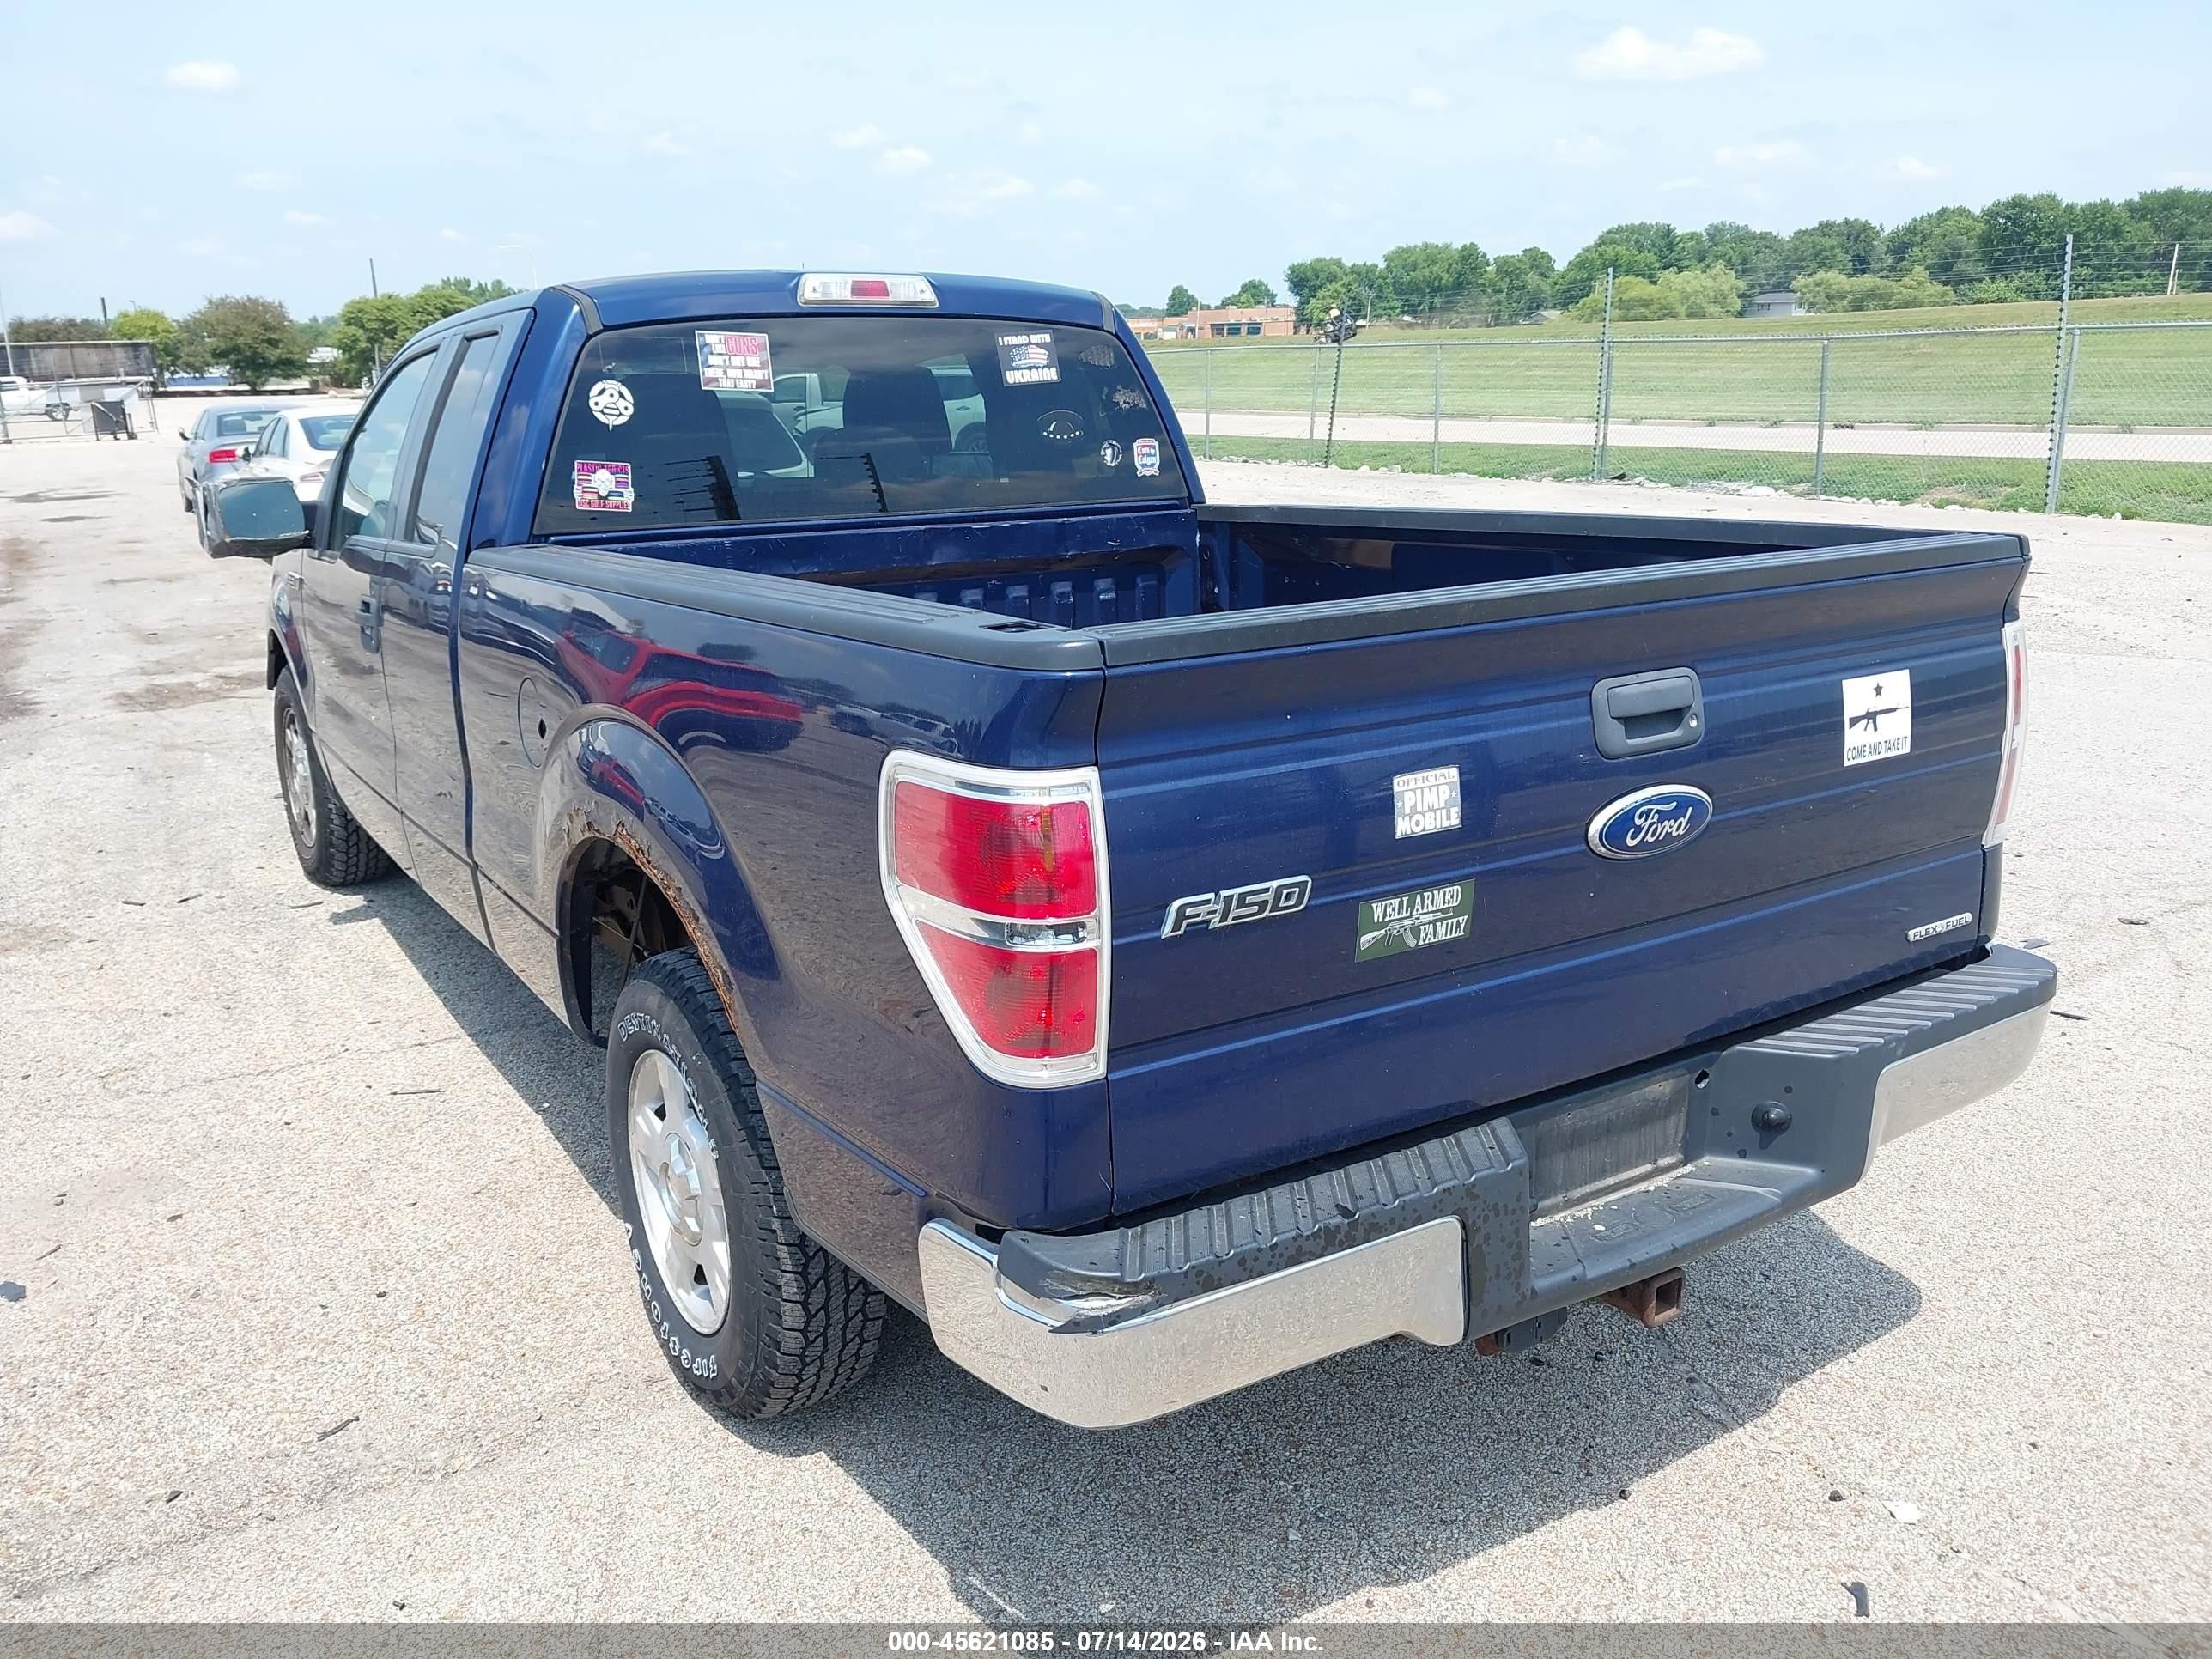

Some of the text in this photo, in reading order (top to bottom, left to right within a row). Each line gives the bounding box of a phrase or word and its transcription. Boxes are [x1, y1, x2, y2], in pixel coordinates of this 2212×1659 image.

[726, 336, 758, 356] GUNS
[998, 333, 1051, 345] I STAND WITH
[1006, 367, 1059, 384] UKRAINE
[590, 500, 605, 508] GOLF
[605, 501, 630, 510] SUPPLIES
[1846, 744, 1867, 762] COME
[1868, 741, 1883, 757] AND
[1883, 738, 1900, 754] TAKE
[1396, 771, 1455, 788] OFFICIAL
[1403, 784, 1450, 815] PIMP
[1396, 806, 1460, 836] MOBILE
[1626, 801, 1693, 847] Ford
[1161, 875, 1312, 939] F-150
[1371, 885, 1462, 923] WELL ARMED
[1418, 915, 1468, 945] FAMILY
[1912, 915, 1970, 940] FLEX FUEL
